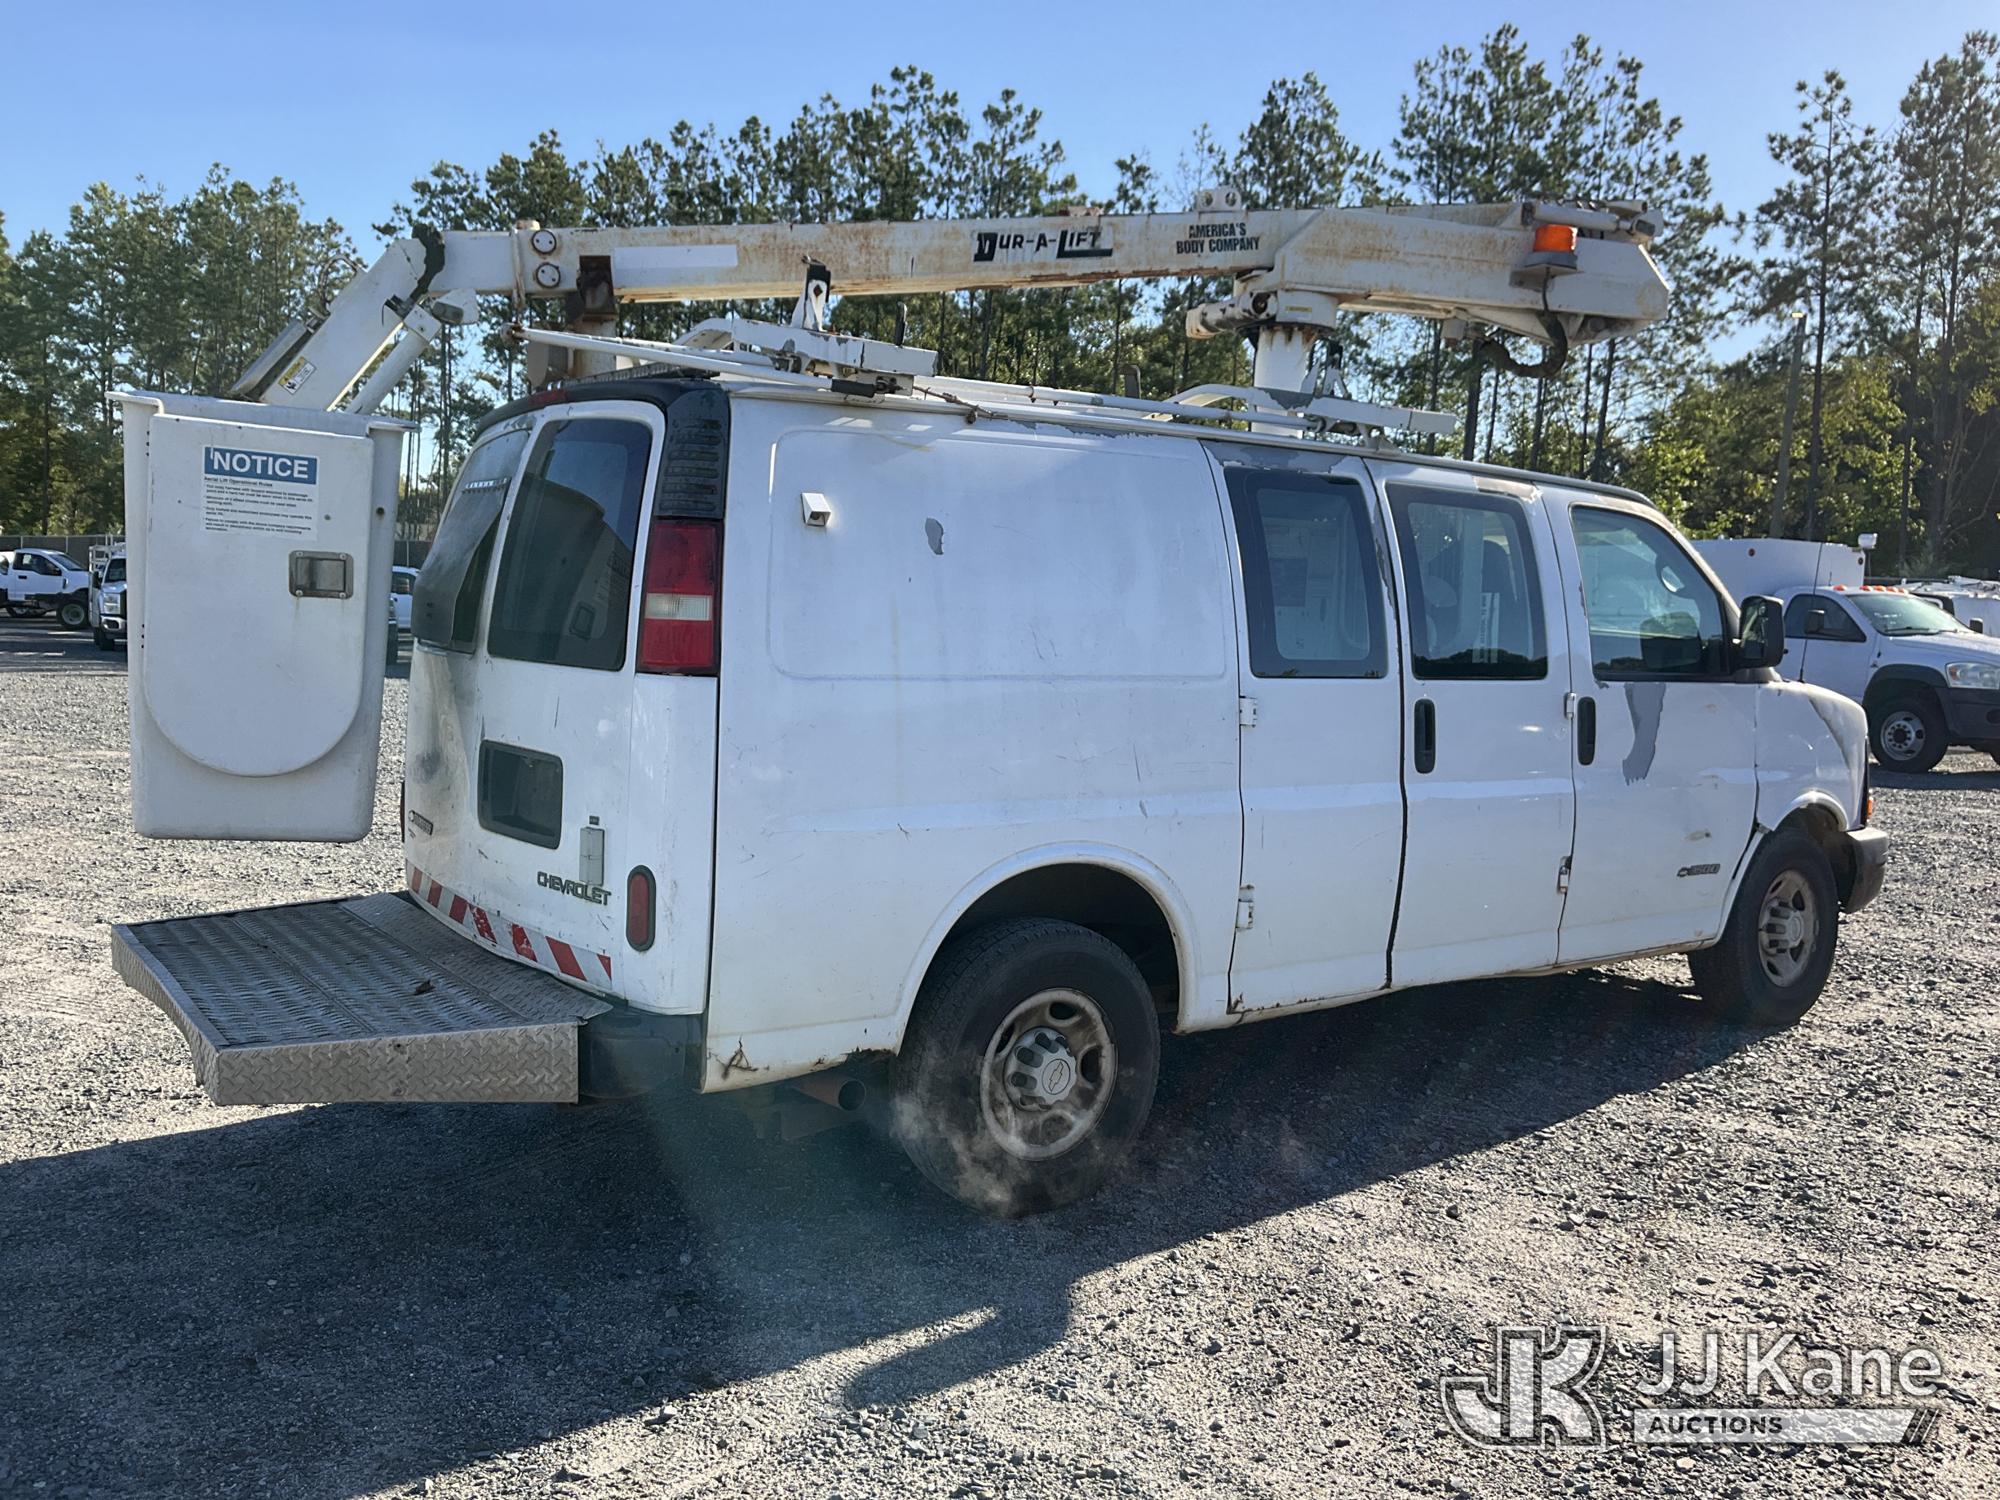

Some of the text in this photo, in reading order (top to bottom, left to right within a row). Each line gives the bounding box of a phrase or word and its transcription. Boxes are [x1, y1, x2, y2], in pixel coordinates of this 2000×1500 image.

[1189, 222, 1247, 239] AMERICA'S
[1176, 236, 1260, 254] BODY COMPANY
[212, 450, 309, 479] NOTICE
[536, 870, 612, 906] CHEVROLET
